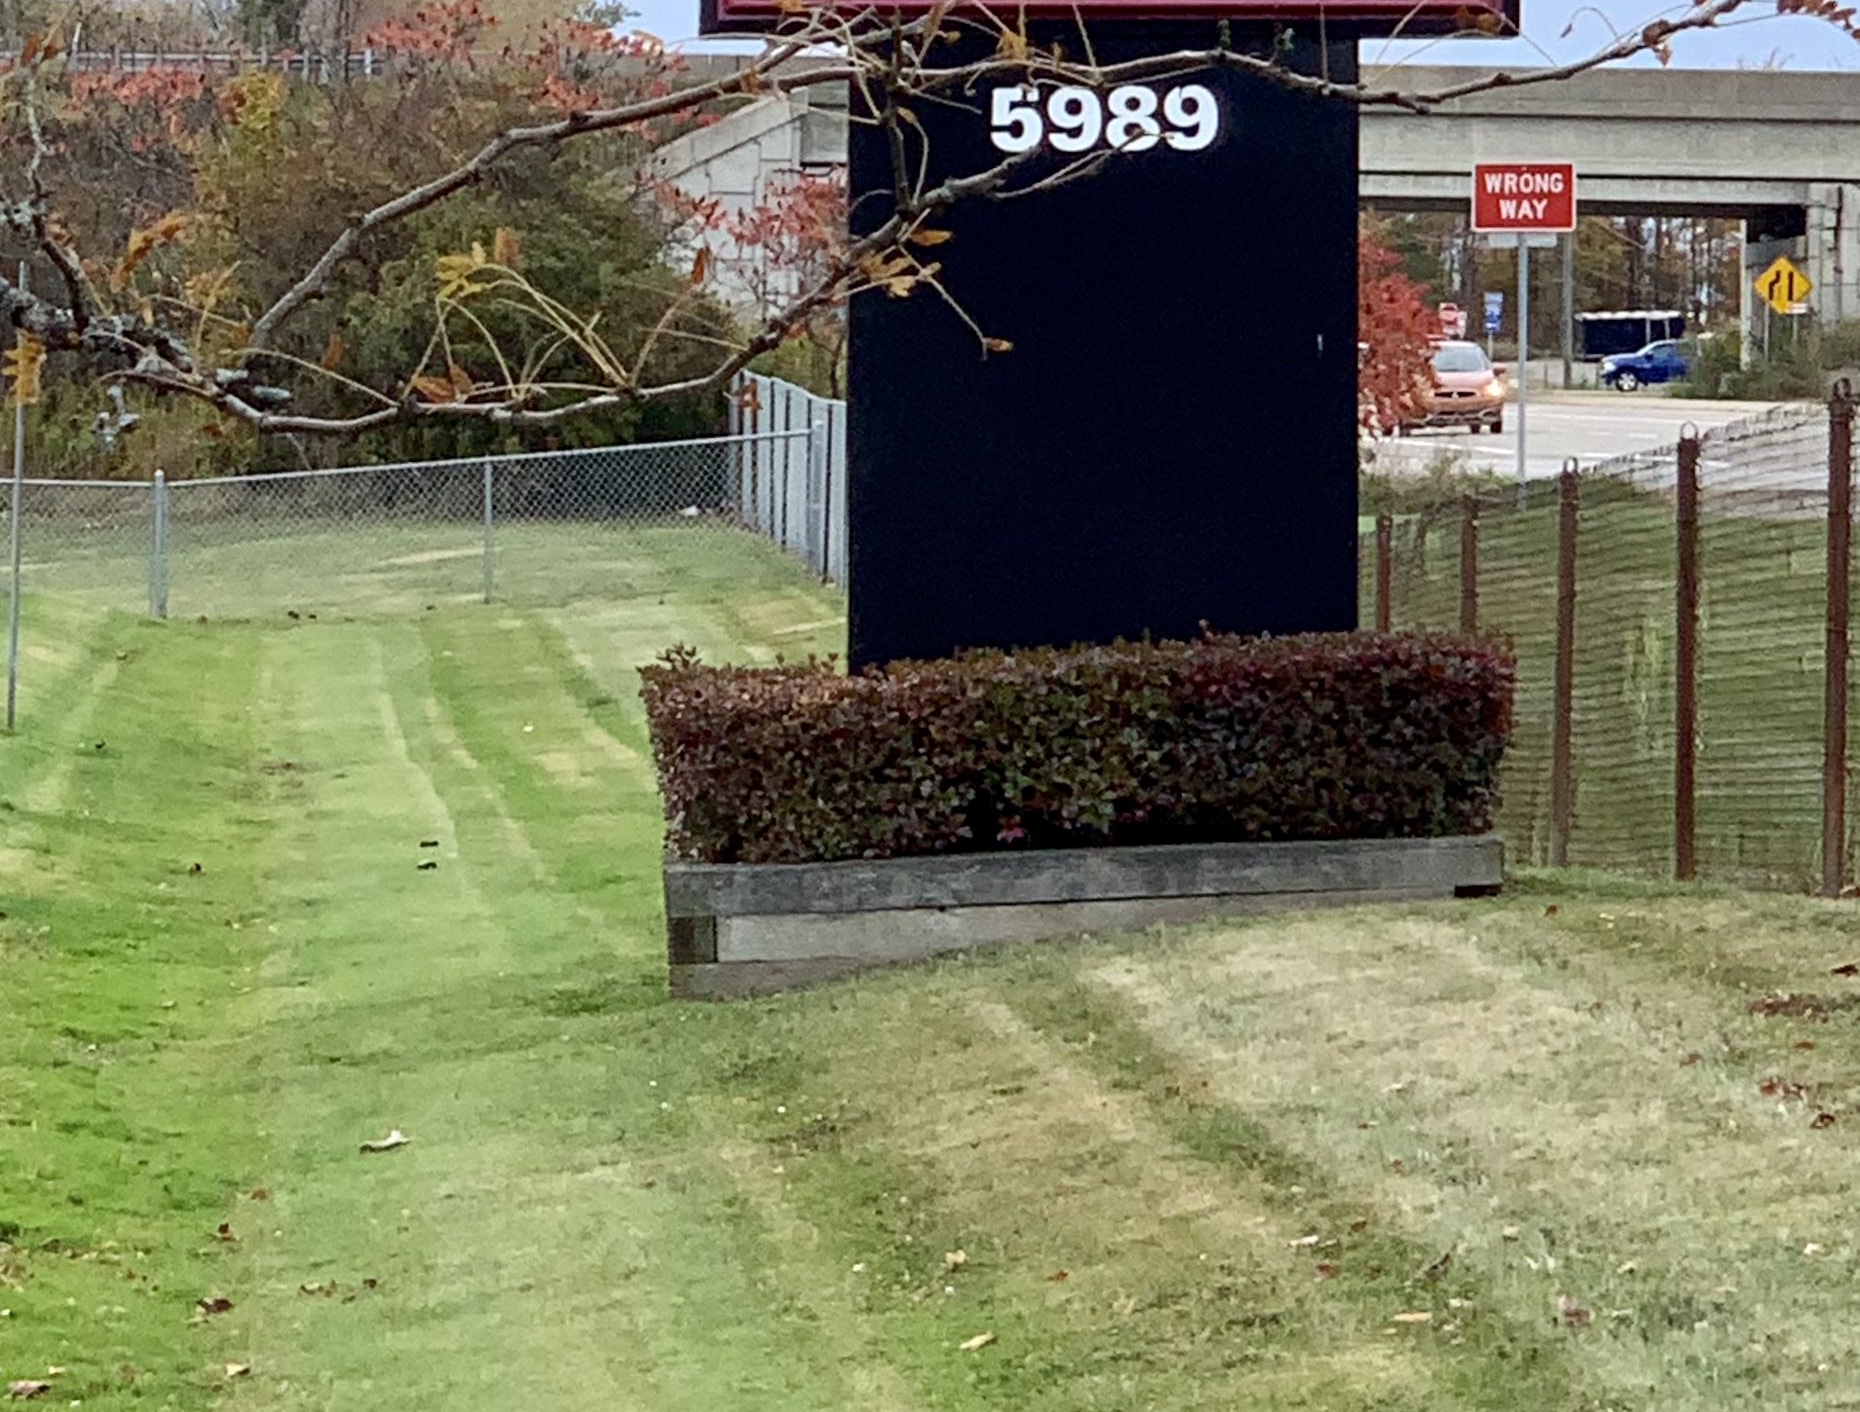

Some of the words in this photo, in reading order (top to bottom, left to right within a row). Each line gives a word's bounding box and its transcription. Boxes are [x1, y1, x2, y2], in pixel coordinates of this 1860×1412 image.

[990, 85, 1219, 152] 5989
[1484, 173, 1564, 194] WRONG
[1499, 199, 1548, 220] WAY
